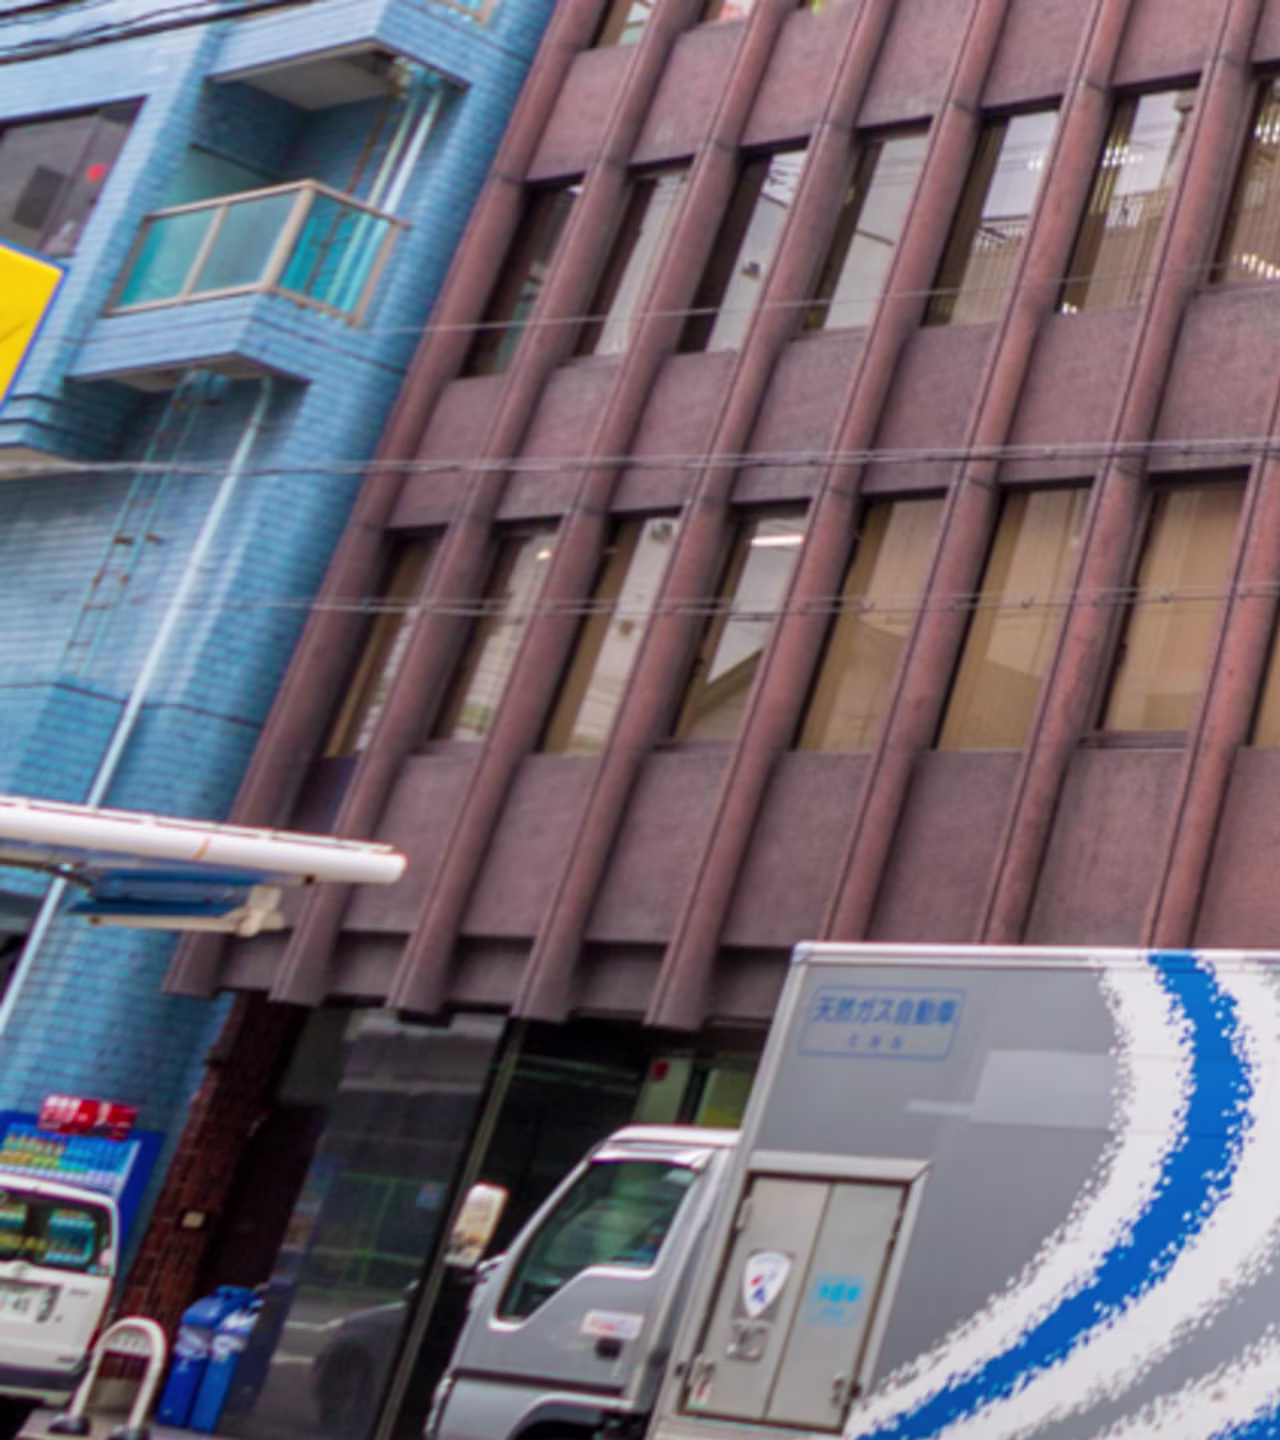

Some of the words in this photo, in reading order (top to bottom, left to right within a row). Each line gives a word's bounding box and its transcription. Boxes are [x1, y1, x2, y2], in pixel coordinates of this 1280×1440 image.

[812, 995, 956, 1025] 天然ガス自動車
